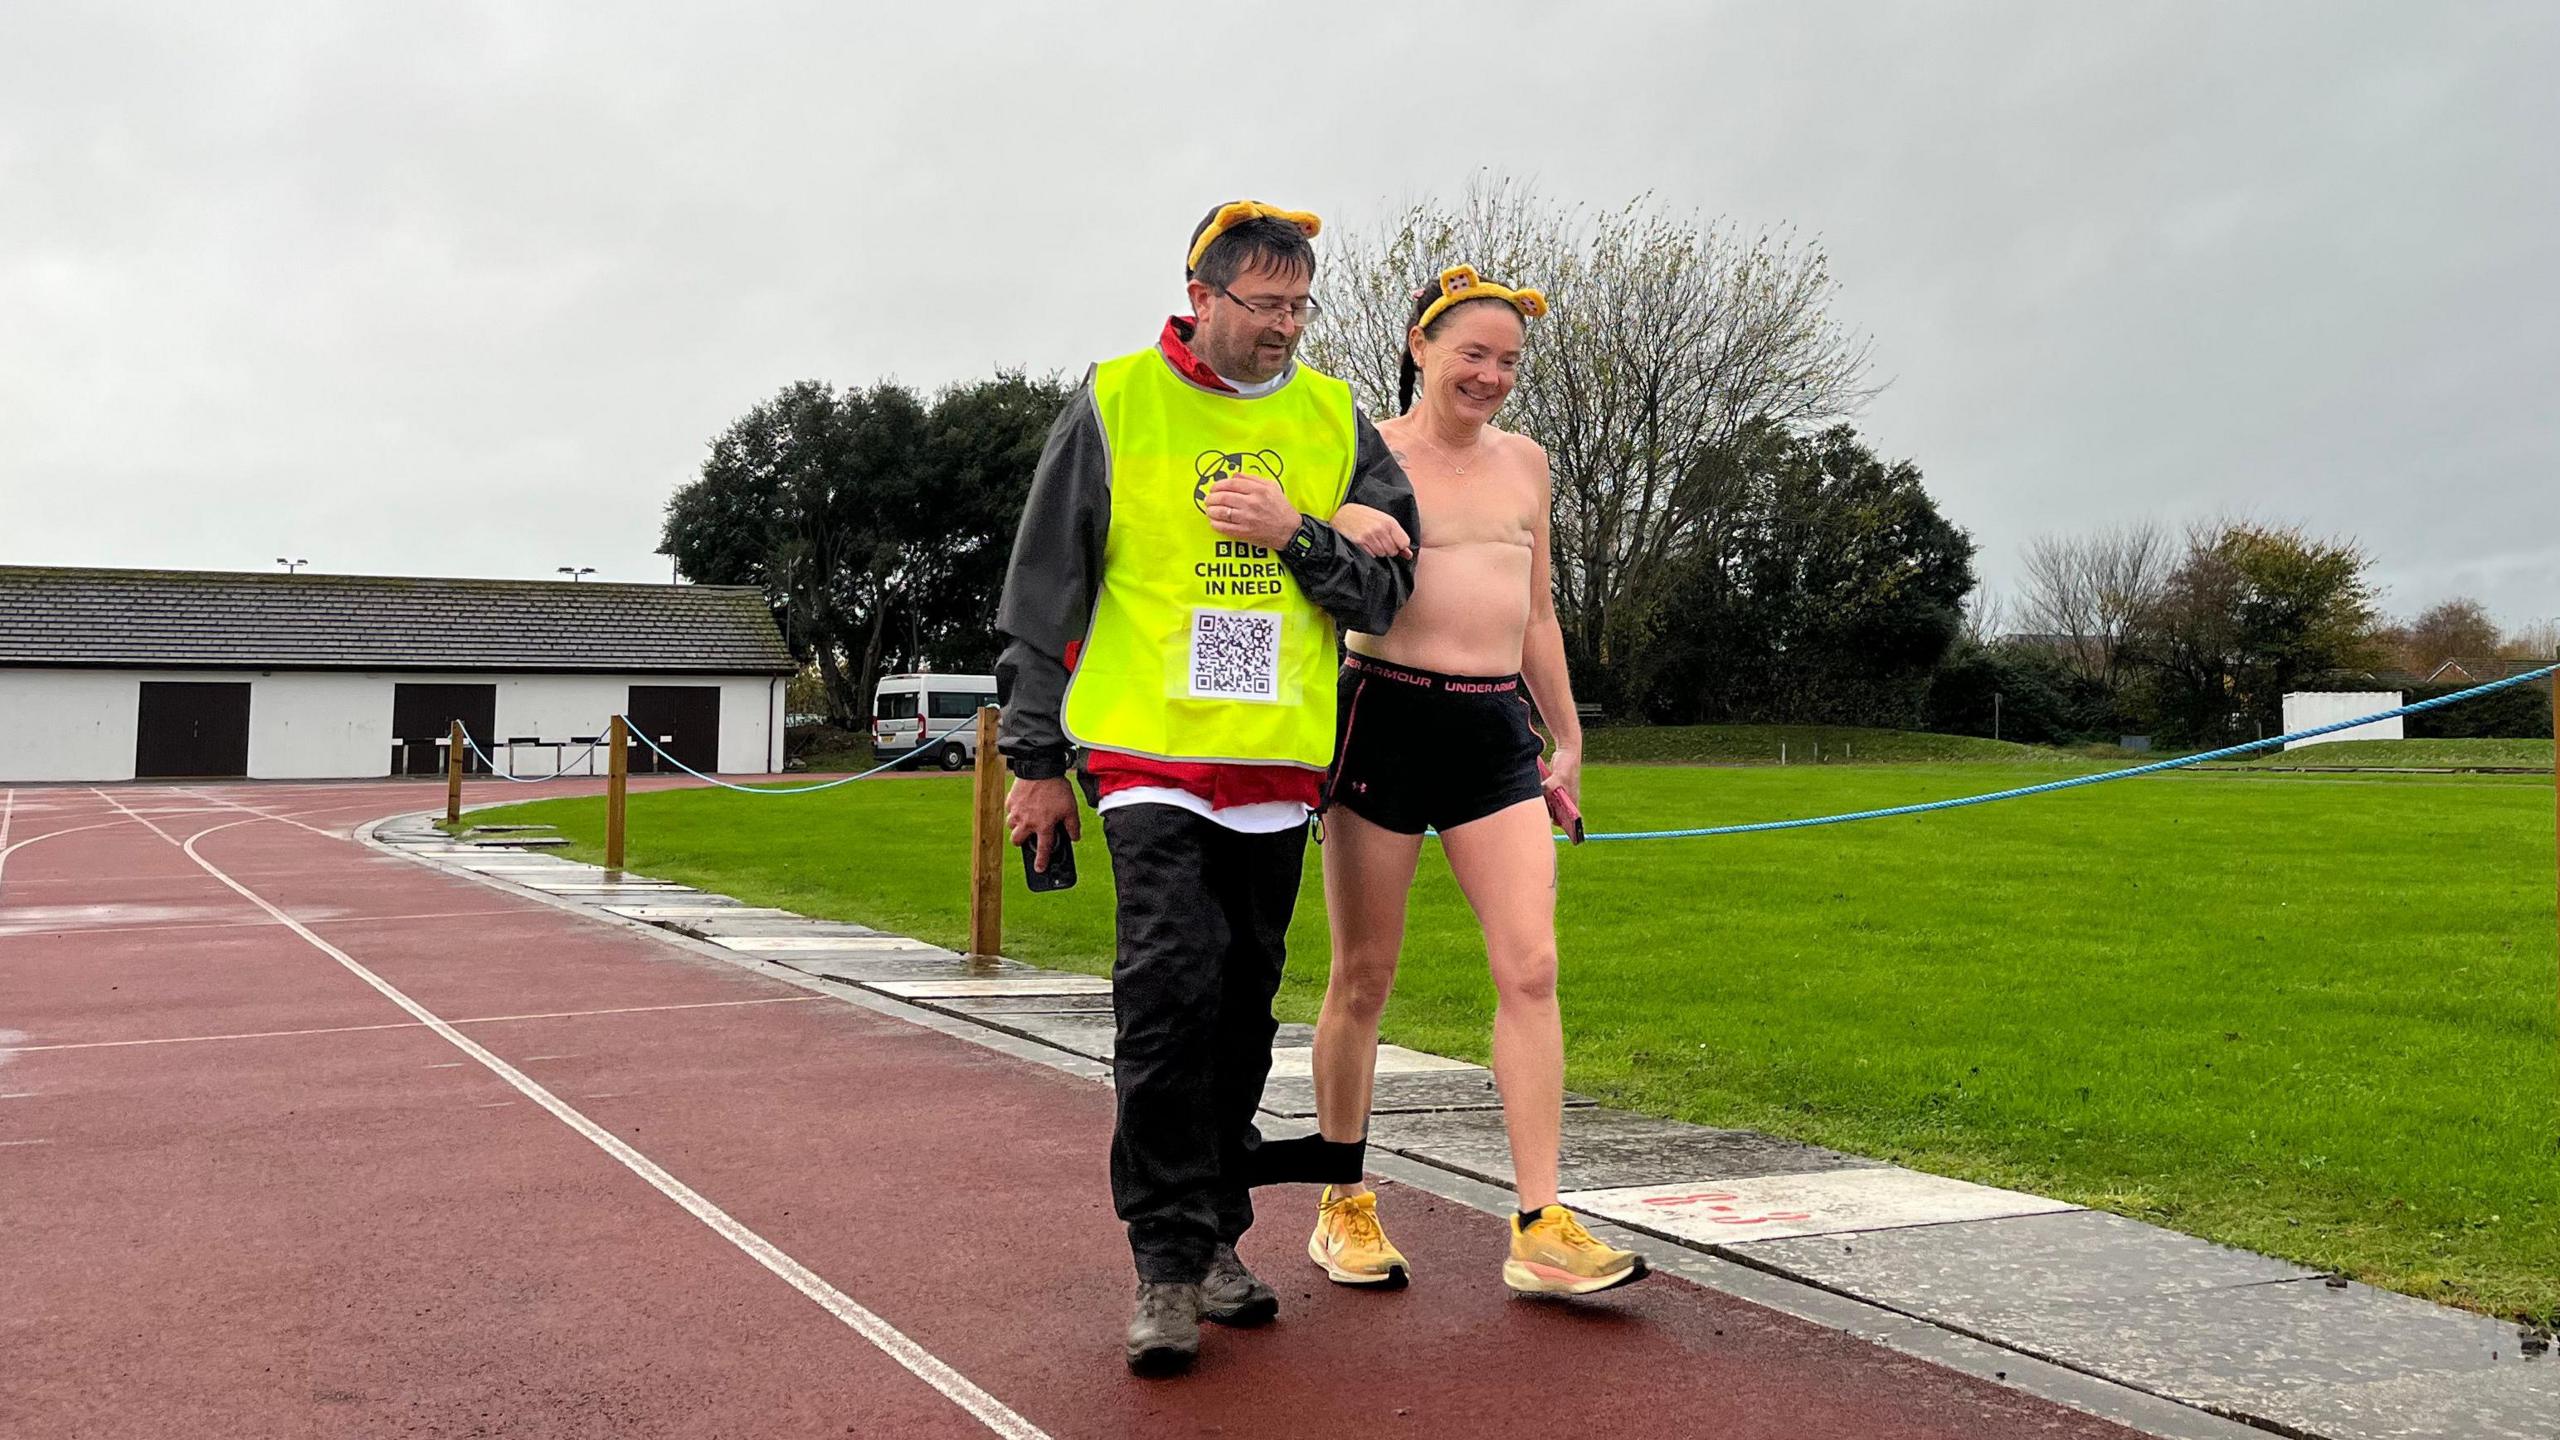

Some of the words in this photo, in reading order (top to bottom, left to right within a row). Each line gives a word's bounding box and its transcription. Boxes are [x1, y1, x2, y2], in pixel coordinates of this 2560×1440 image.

[1217, 542, 1267, 557] BBC
[1206, 581, 1225, 595] IN
[1231, 580, 1282, 595] NEED
[1362, 662, 1432, 688] ARMOUR
